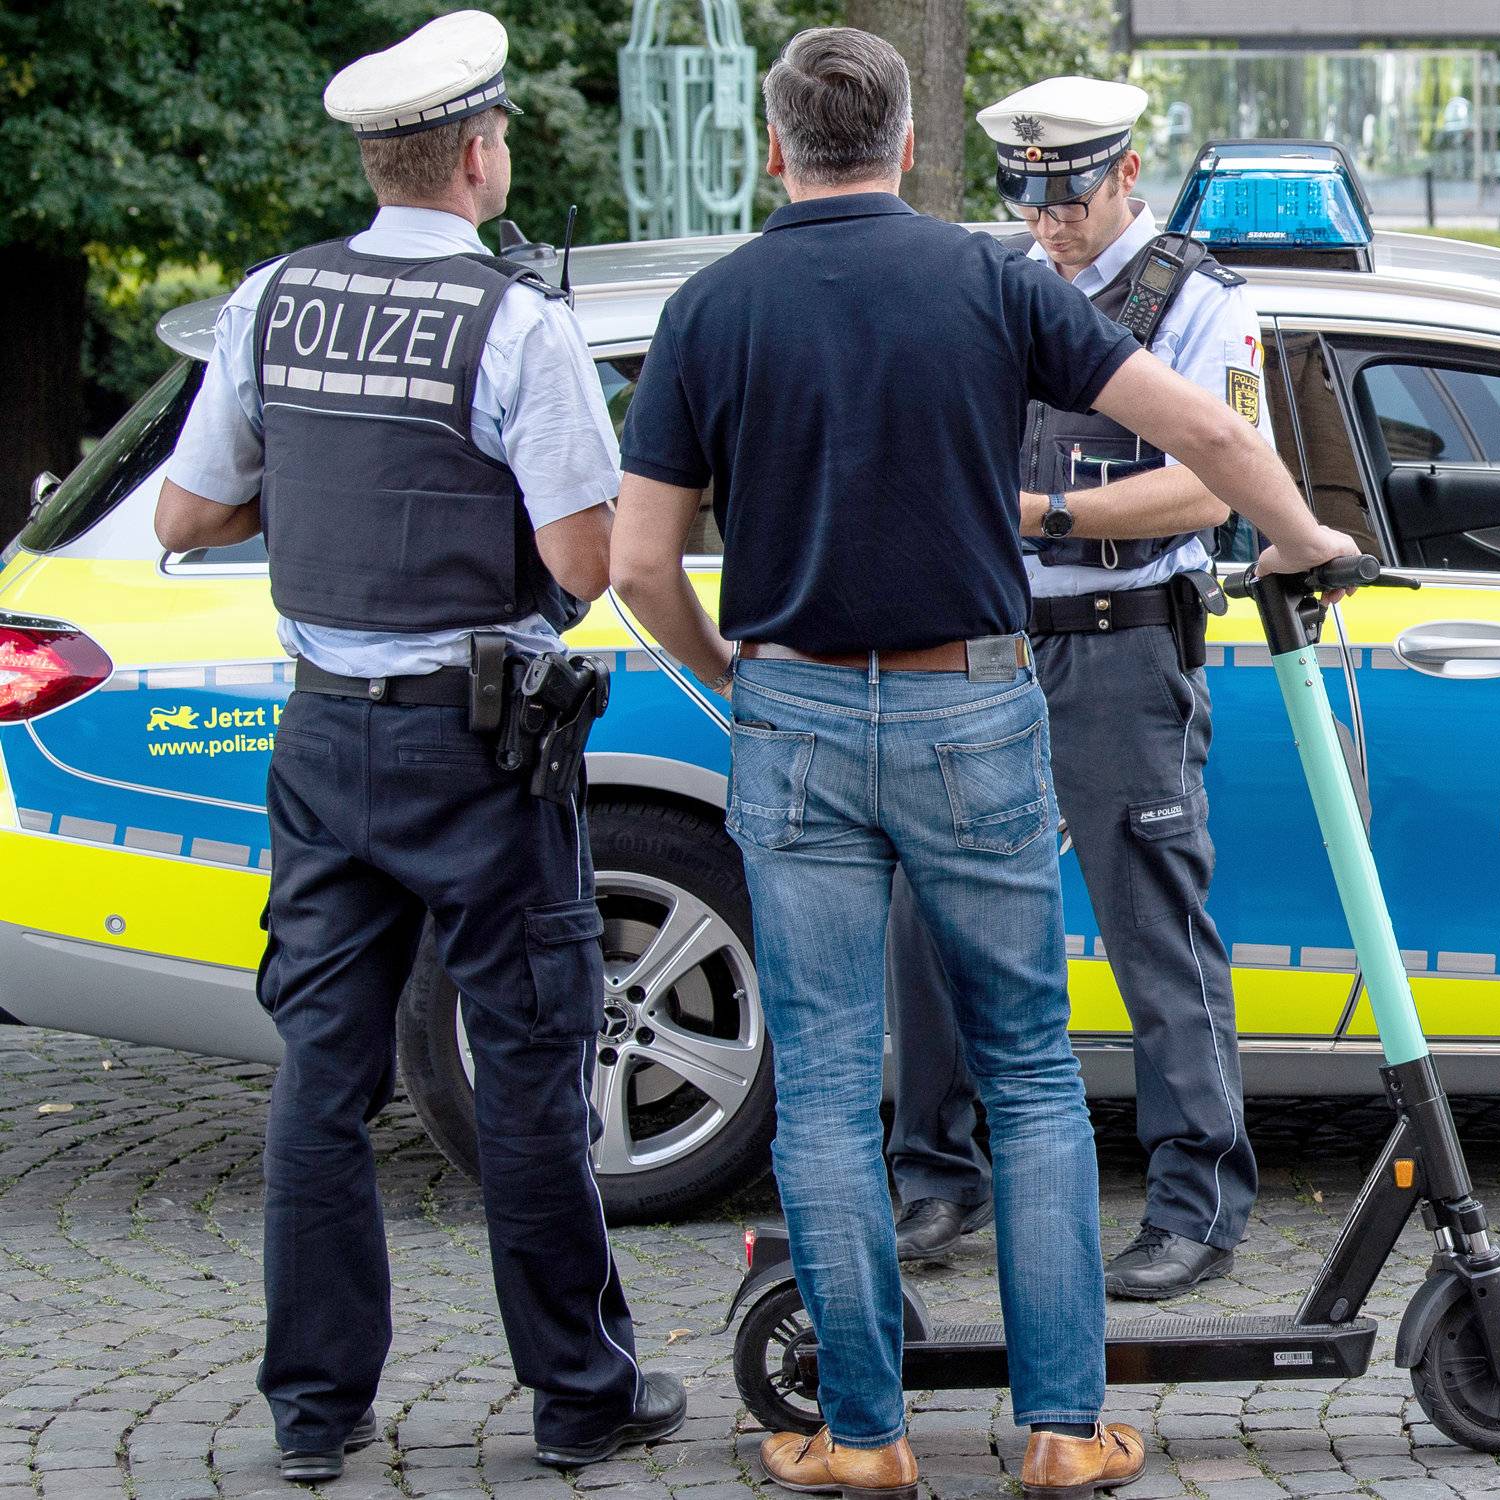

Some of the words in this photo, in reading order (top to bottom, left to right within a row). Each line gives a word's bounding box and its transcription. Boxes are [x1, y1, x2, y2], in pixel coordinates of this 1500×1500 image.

[265, 295, 464, 369] POLIZEI
[203, 706, 266, 729] Jetzt
[1157, 805, 1182, 817] POLIZEI
